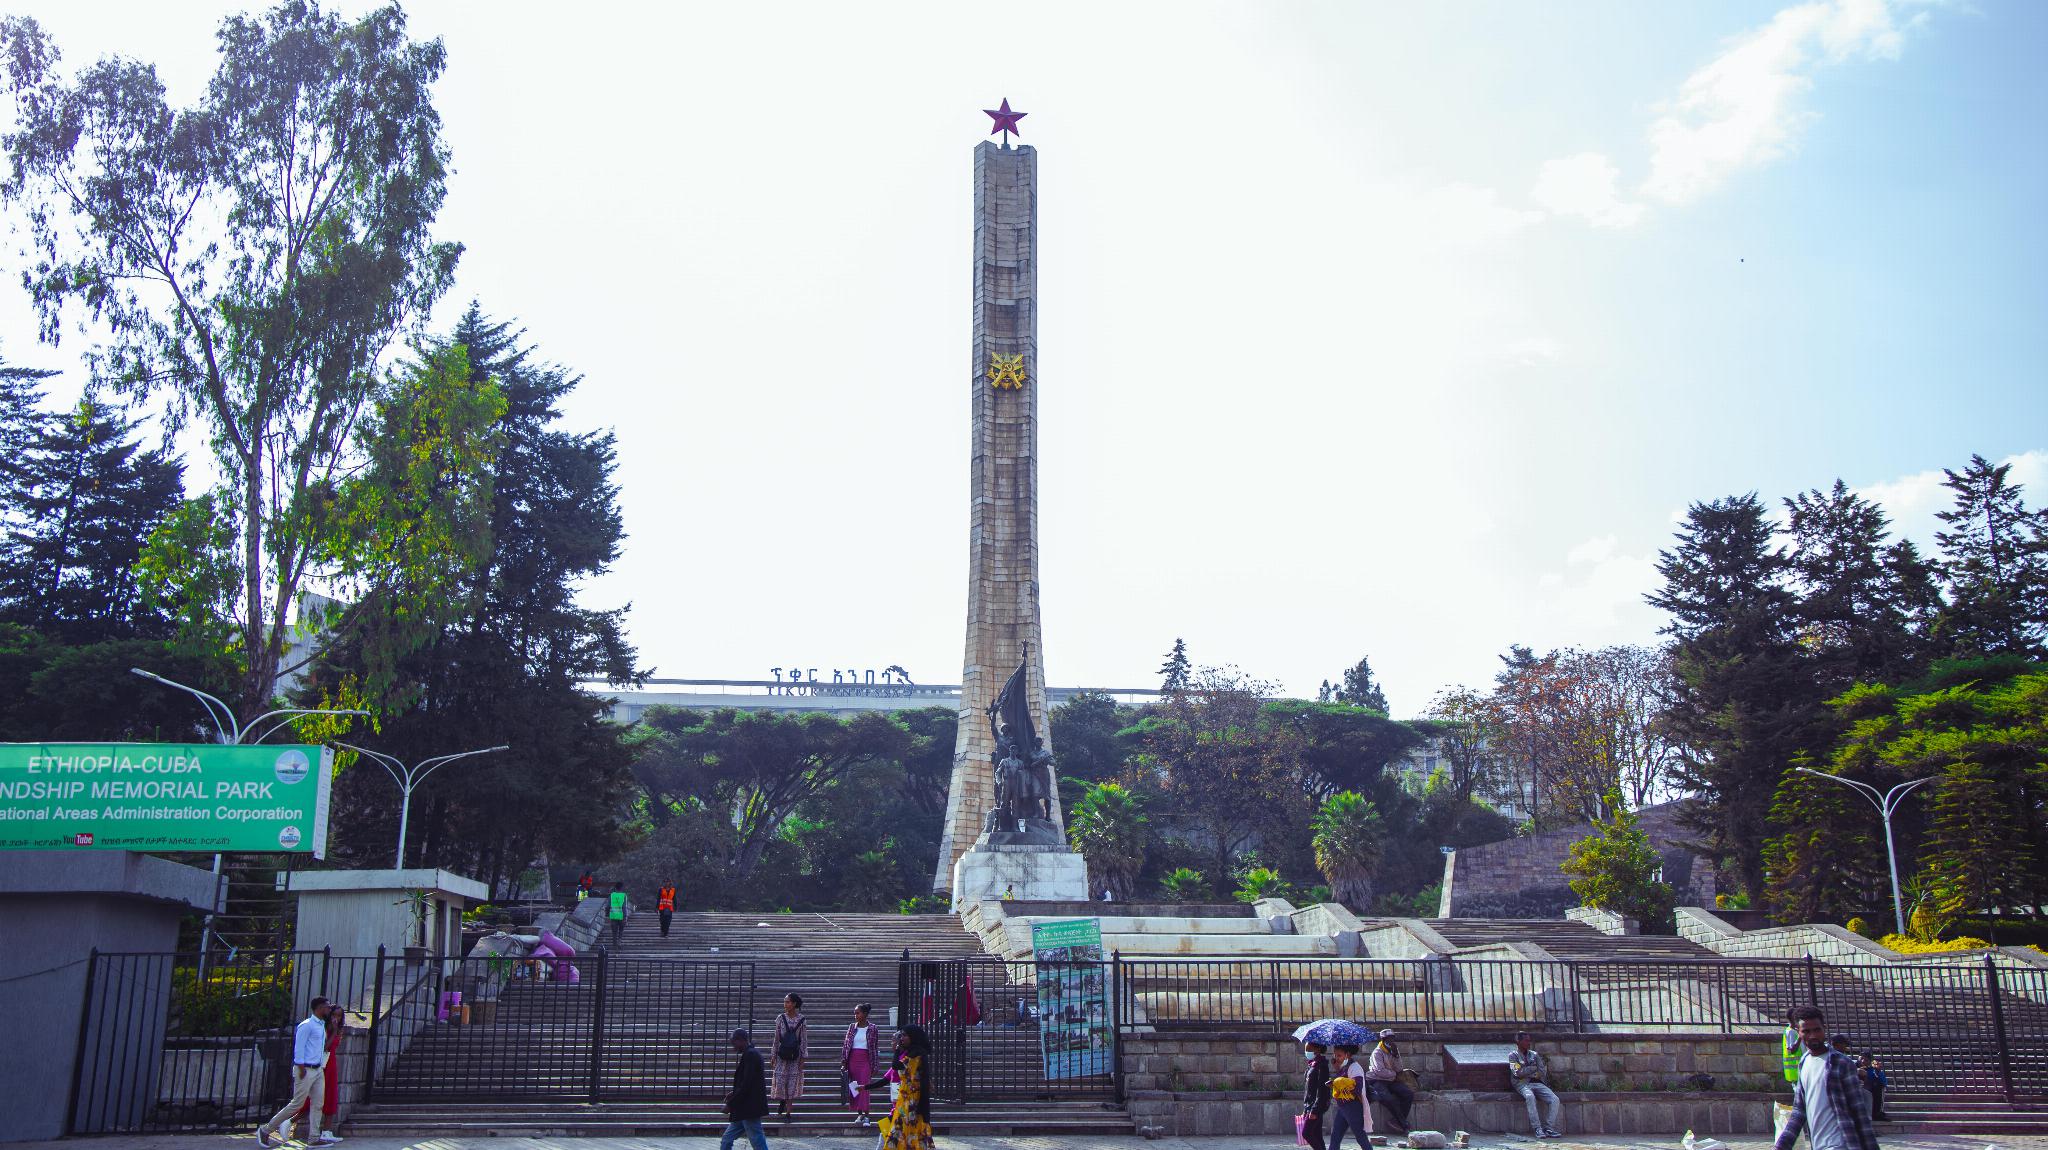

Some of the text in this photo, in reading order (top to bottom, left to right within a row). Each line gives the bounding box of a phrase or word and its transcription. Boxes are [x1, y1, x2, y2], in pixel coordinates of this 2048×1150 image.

[766, 686, 818, 697] TIKUR
[28, 756, 202, 774] ETHIOPIA-CUBA
[91, 781, 209, 799] MEMORIAL
[215, 781, 274, 799] PARK
[52, 806, 98, 820] Areas
[102, 806, 210, 820] Administration
[215, 806, 303, 822] Corporation
